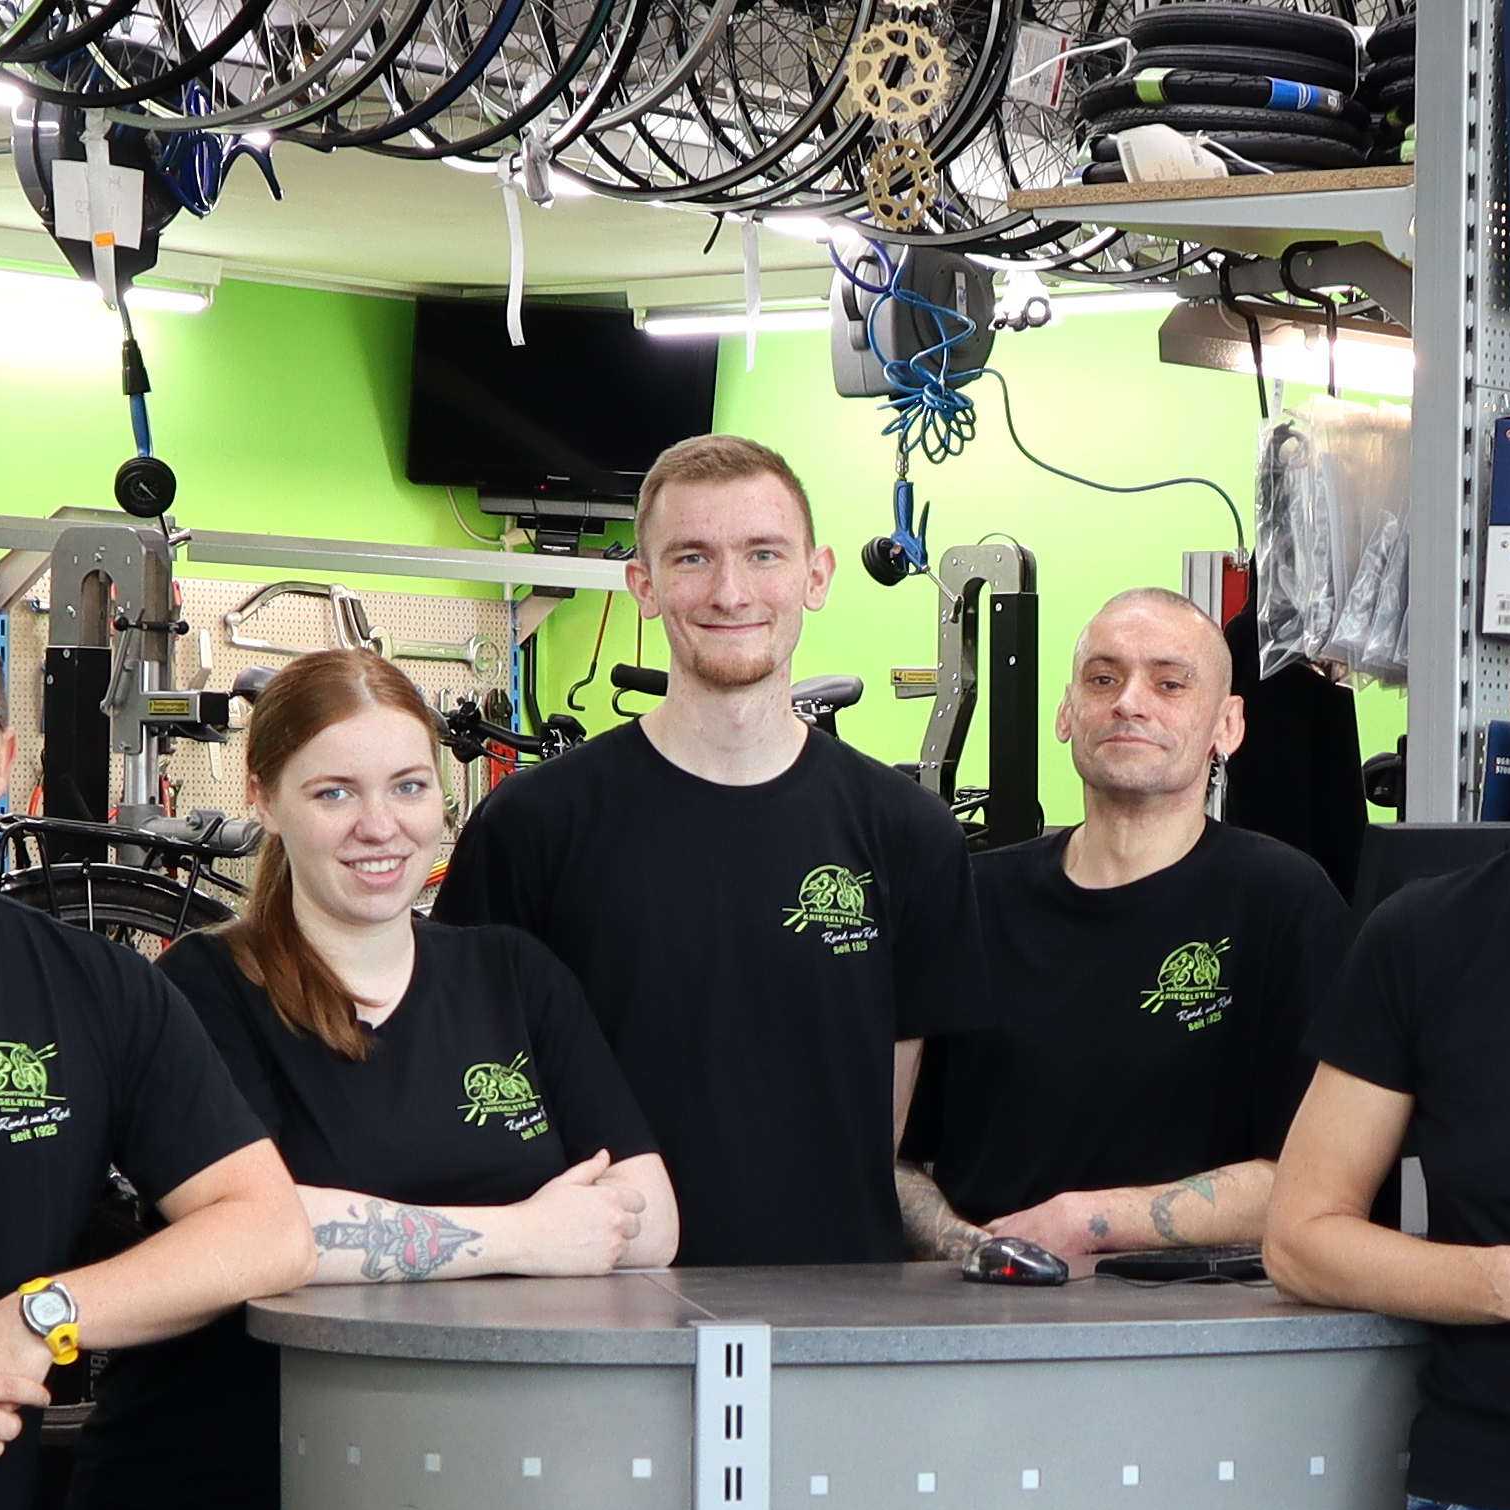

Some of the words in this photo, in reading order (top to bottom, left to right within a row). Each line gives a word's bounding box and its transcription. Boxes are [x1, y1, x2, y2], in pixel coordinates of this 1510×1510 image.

[802, 914, 862, 927] KRIEGELSTEIN
[10, 1128, 32, 1143] seit
[33, 1123, 59, 1138] 1925
